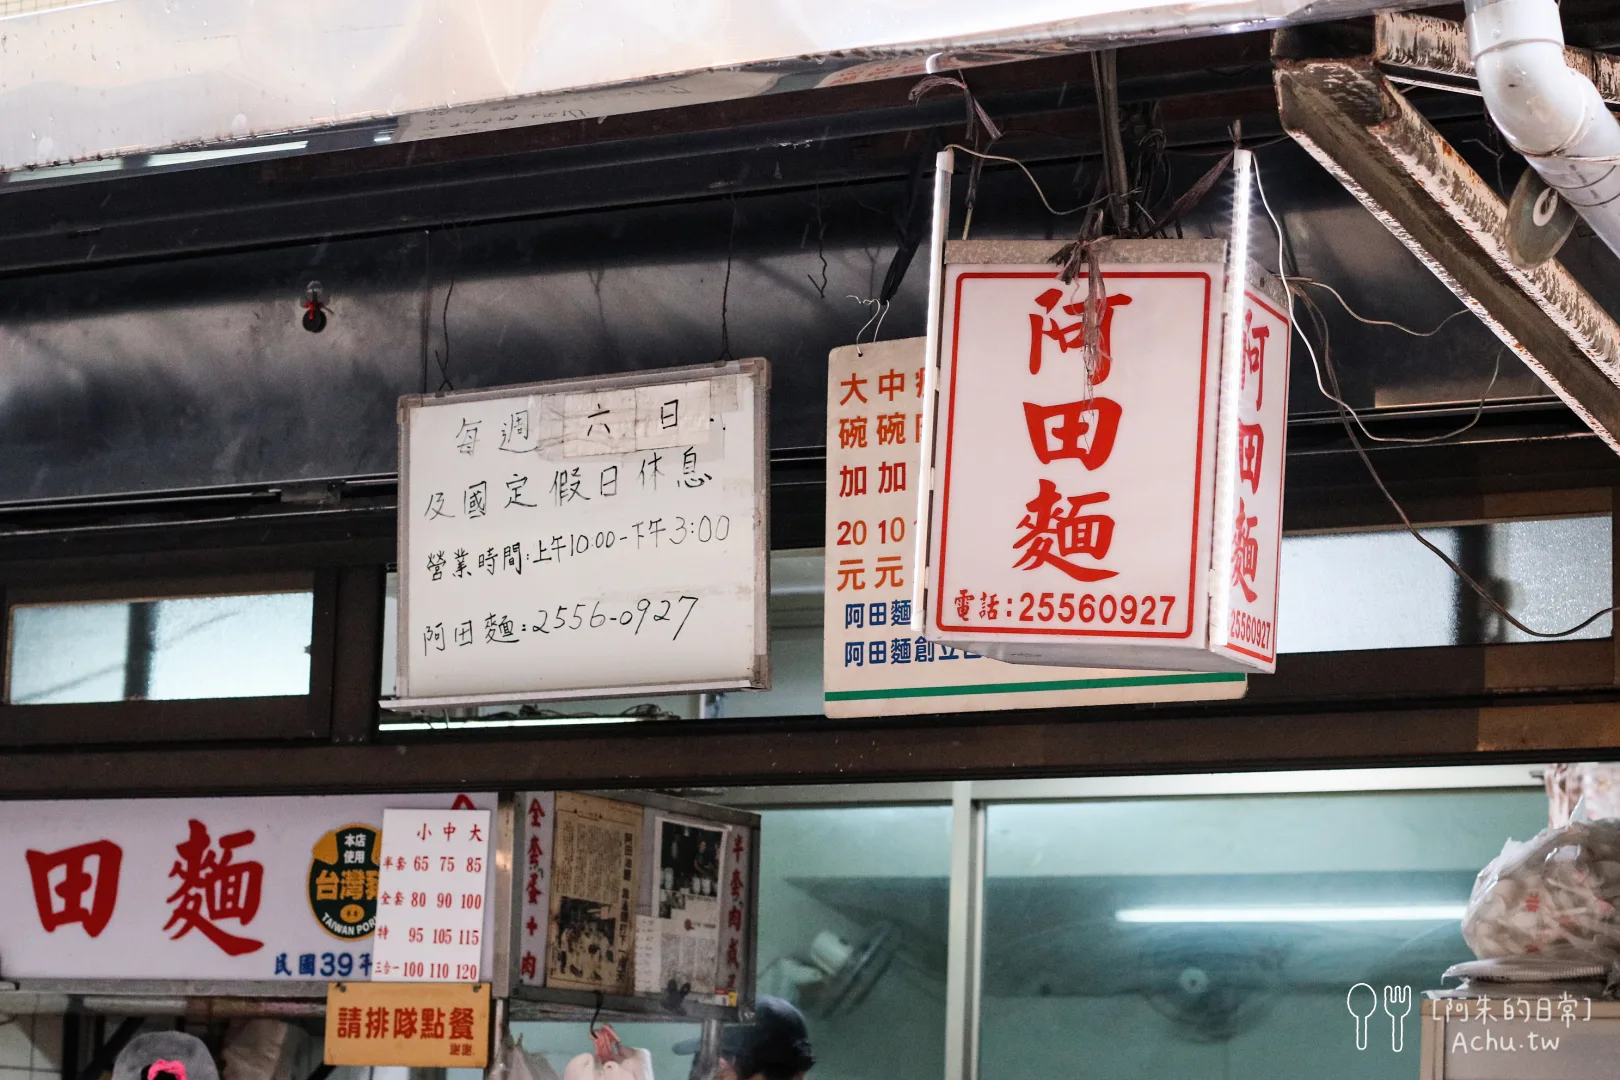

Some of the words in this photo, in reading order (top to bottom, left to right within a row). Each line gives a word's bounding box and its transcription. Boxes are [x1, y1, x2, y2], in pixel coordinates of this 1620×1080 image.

[1012, 288, 1132, 582] 阿田麵
[1231, 309, 1270, 603] 阿田麵
[424, 446, 713, 521] 及國定假日休息
[1230, 608, 1271, 650] 25560927
[344, 833, 367, 848] 本店
[416, 822, 432, 842] 小
[443, 822, 457, 842] 中
[469, 823, 484, 843] 大
[343, 850, 366, 864] 使用
[413, 855, 429, 872] 65
[440, 856, 455, 872] 75
[466, 857, 482, 873] 85
[411, 892, 426, 907] 80
[437, 892, 453, 908] 90
[461, 893, 482, 910] 100
[321, 911, 355, 936] TAIWAN
[356, 916, 377, 934] POR
[408, 927, 424, 943] 95
[433, 928, 453, 945] 105
[459, 929, 479, 946] 115
[403, 961, 424, 978] 100
[430, 963, 450, 979] 110
[456, 964, 477, 981] 120
[337, 1005, 475, 1041] 請排隊點餐
